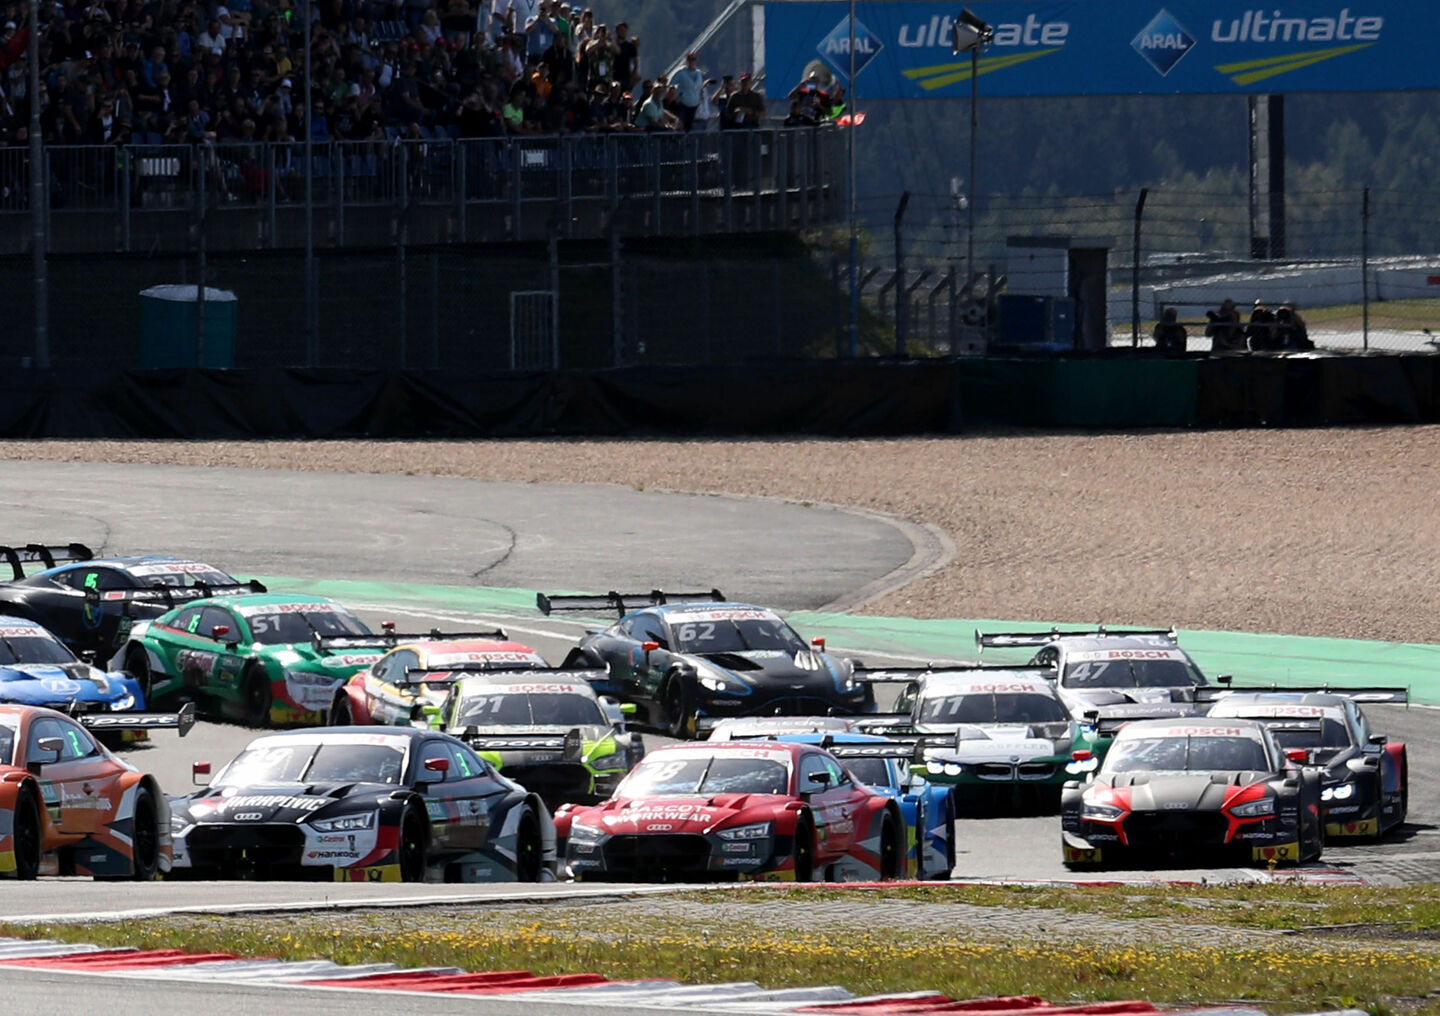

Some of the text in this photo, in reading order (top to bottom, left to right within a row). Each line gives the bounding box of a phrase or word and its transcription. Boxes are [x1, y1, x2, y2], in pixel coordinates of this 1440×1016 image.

[898, 13, 1070, 48] ultate
[1211, 8, 1384, 43] ultimate
[1140, 33, 1187, 50] ARAL
[252, 615, 281, 634] 51
[679, 623, 716, 642] 62
[468, 653, 529, 661] BOSCH
[1108, 651, 1171, 659] BOSCH
[1070, 662, 1110, 681] 47
[970, 684, 1035, 692] BOSCH
[464, 695, 505, 718] 21
[931, 696, 964, 717] 11
[1257, 707, 1325, 716] BOSCH
[1169, 727, 1241, 736] BOSCH
[621, 804, 704, 816] MASCOT
